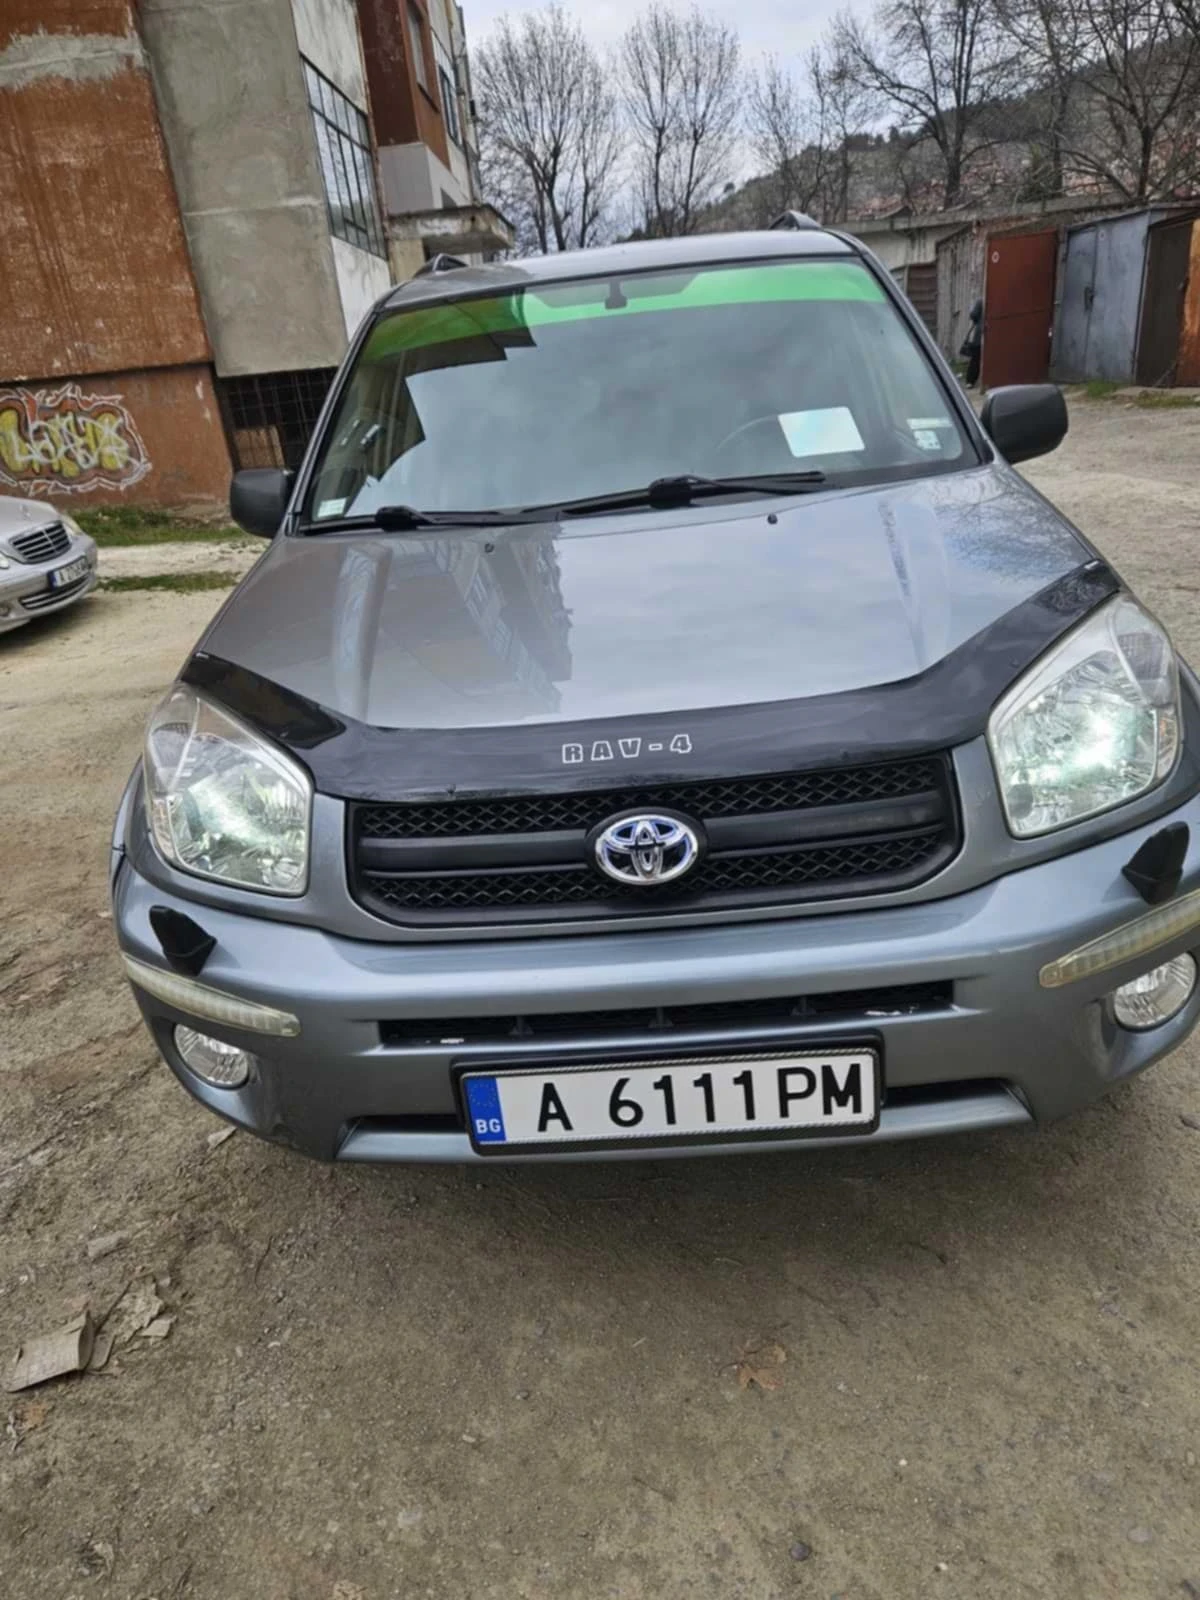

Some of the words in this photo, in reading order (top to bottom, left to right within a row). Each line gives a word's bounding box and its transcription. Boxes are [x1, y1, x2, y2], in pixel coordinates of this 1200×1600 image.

[561, 733, 693, 764] RAV-4
[537, 1082, 573, 1133] A
[476, 1118, 501, 1134] BG
